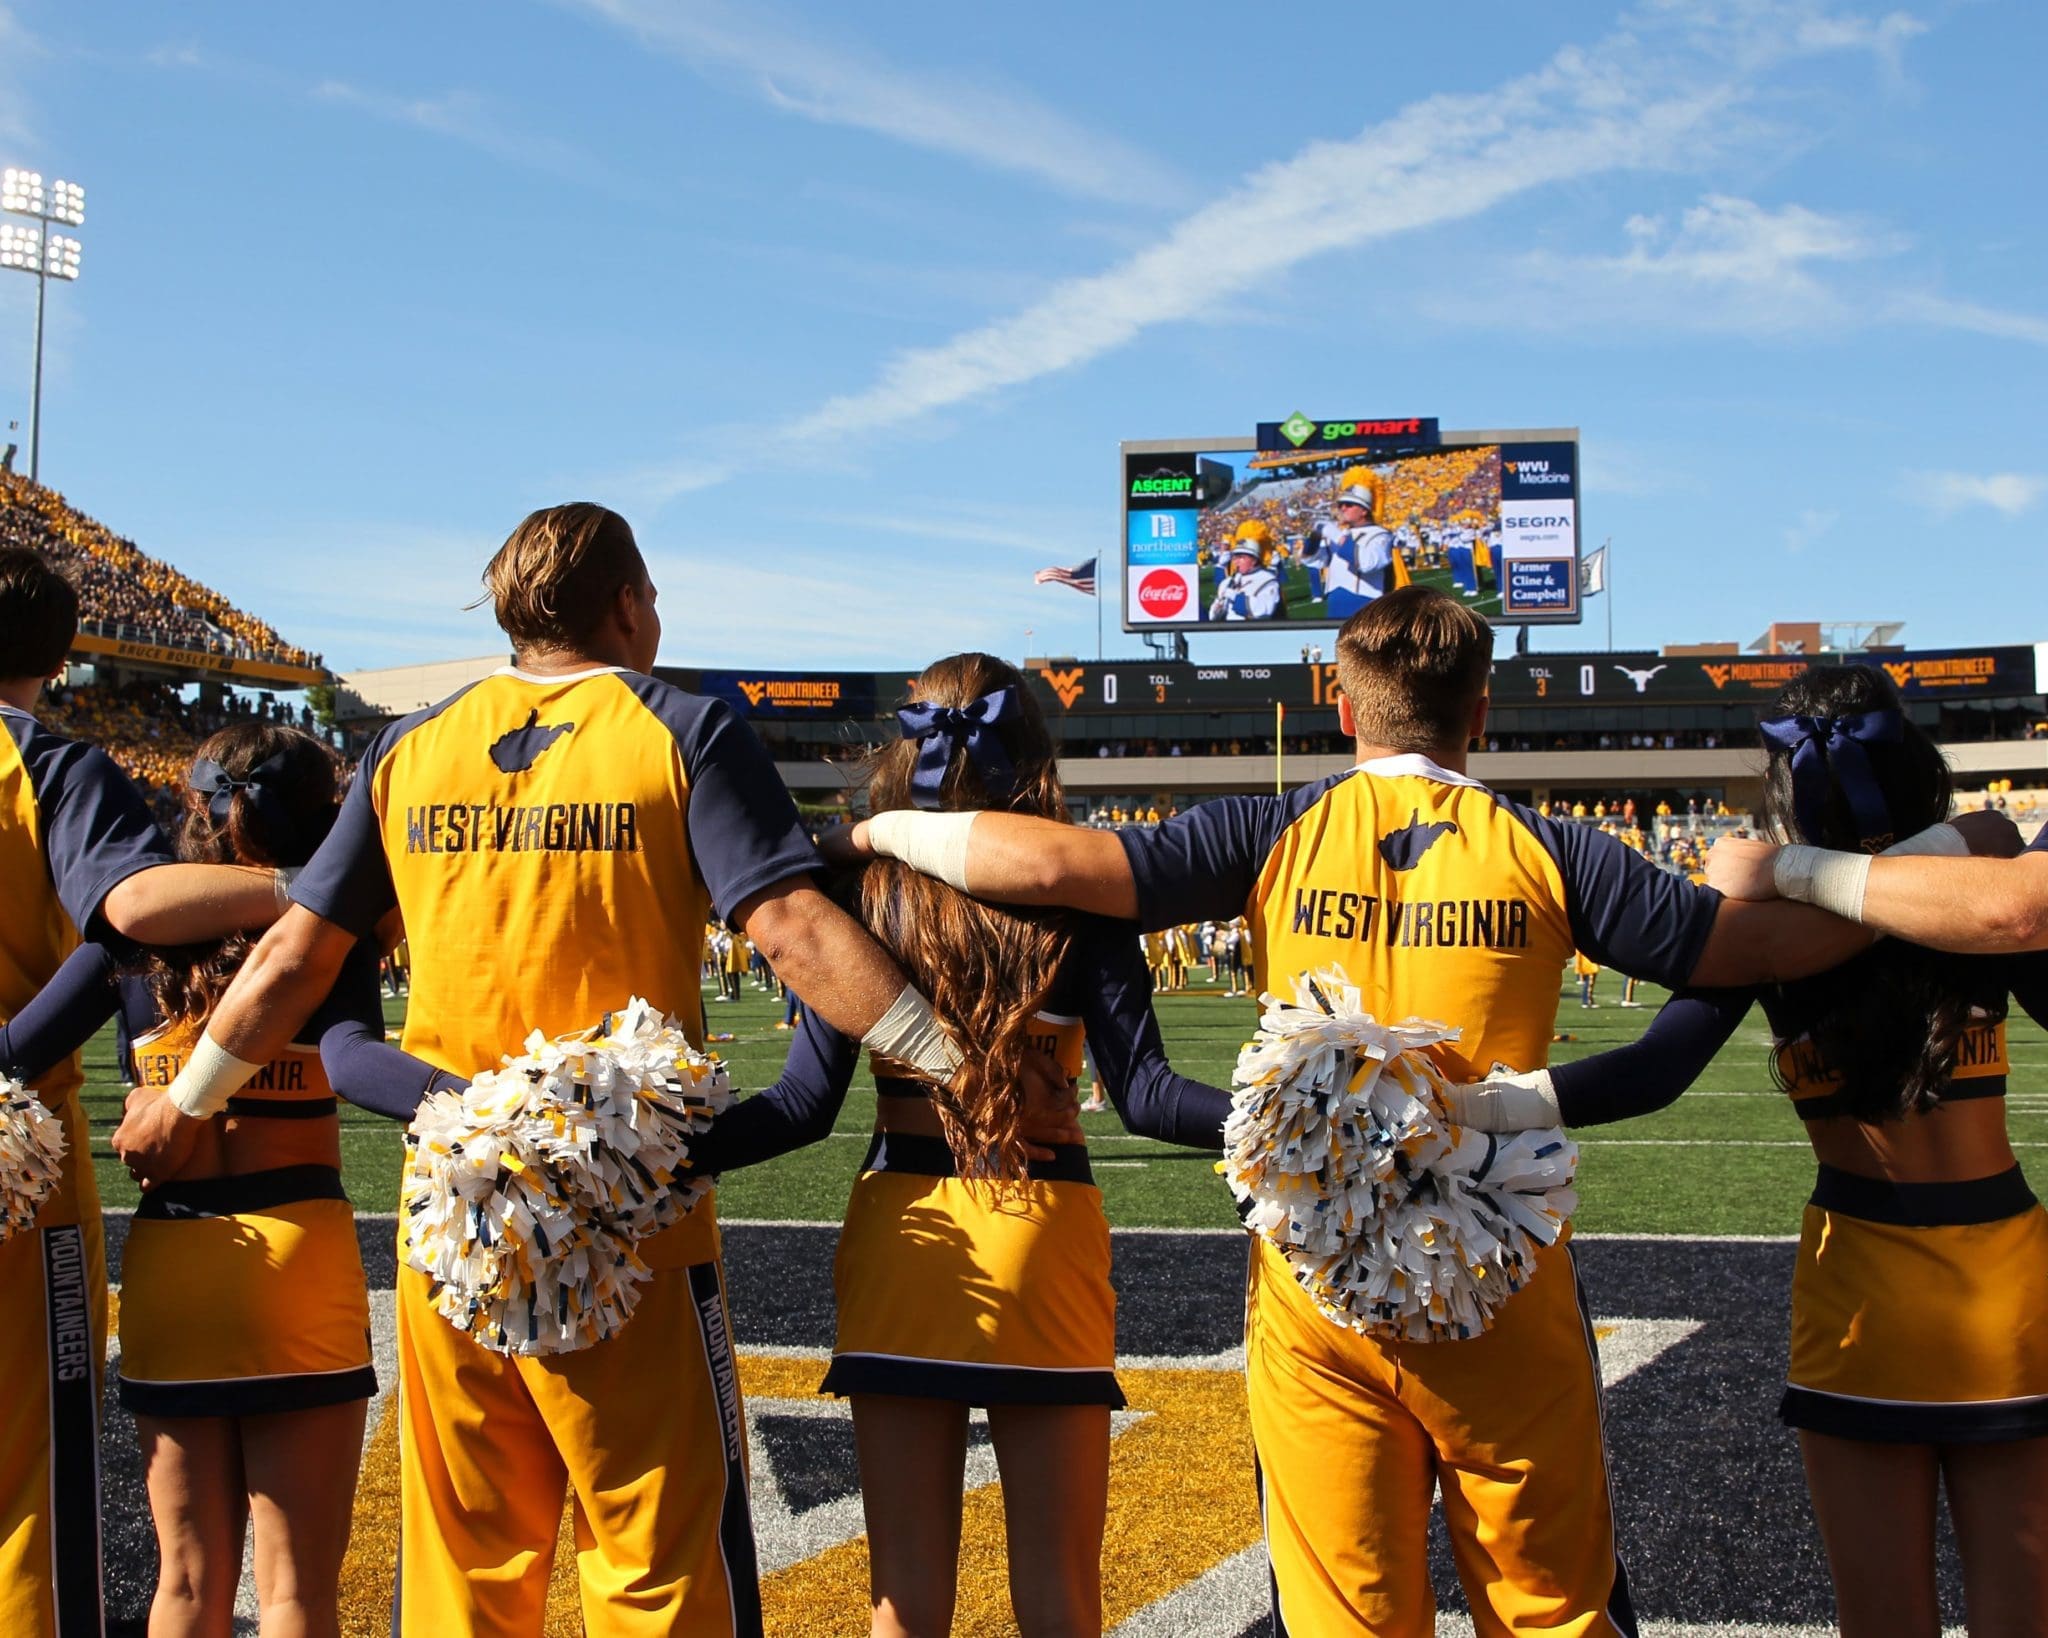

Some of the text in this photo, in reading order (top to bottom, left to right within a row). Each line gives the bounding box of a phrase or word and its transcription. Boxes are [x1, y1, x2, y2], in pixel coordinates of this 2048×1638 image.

[1322, 417, 1420, 440] gomart
[1517, 460, 1549, 473] WVU
[1131, 478, 1193, 493] ASCENT
[1519, 472, 1570, 484] Medicine
[1505, 516, 1570, 529] SEGRA
[1132, 540, 1194, 553] northeast
[1512, 562, 1551, 573] Farmer
[1512, 575, 1555, 586] Cline &
[1512, 588, 1566, 602] Campbell
[1197, 668, 1271, 680] DOWN TO GO
[1580, 665, 1595, 695] 0
[766, 681, 840, 698] MOUNTAINEER
[1103, 674, 1117, 704] 0
[1156, 685, 1165, 703] 3
[1536, 678, 1546, 697] 3
[408, 802, 637, 853] WEST VIRGINIA
[1292, 887, 1528, 948] WEST VIRGINIA
[49, 1228, 88, 1382] MOUNTAINEERS
[700, 1293, 740, 1463] MOUNTAINEERS
